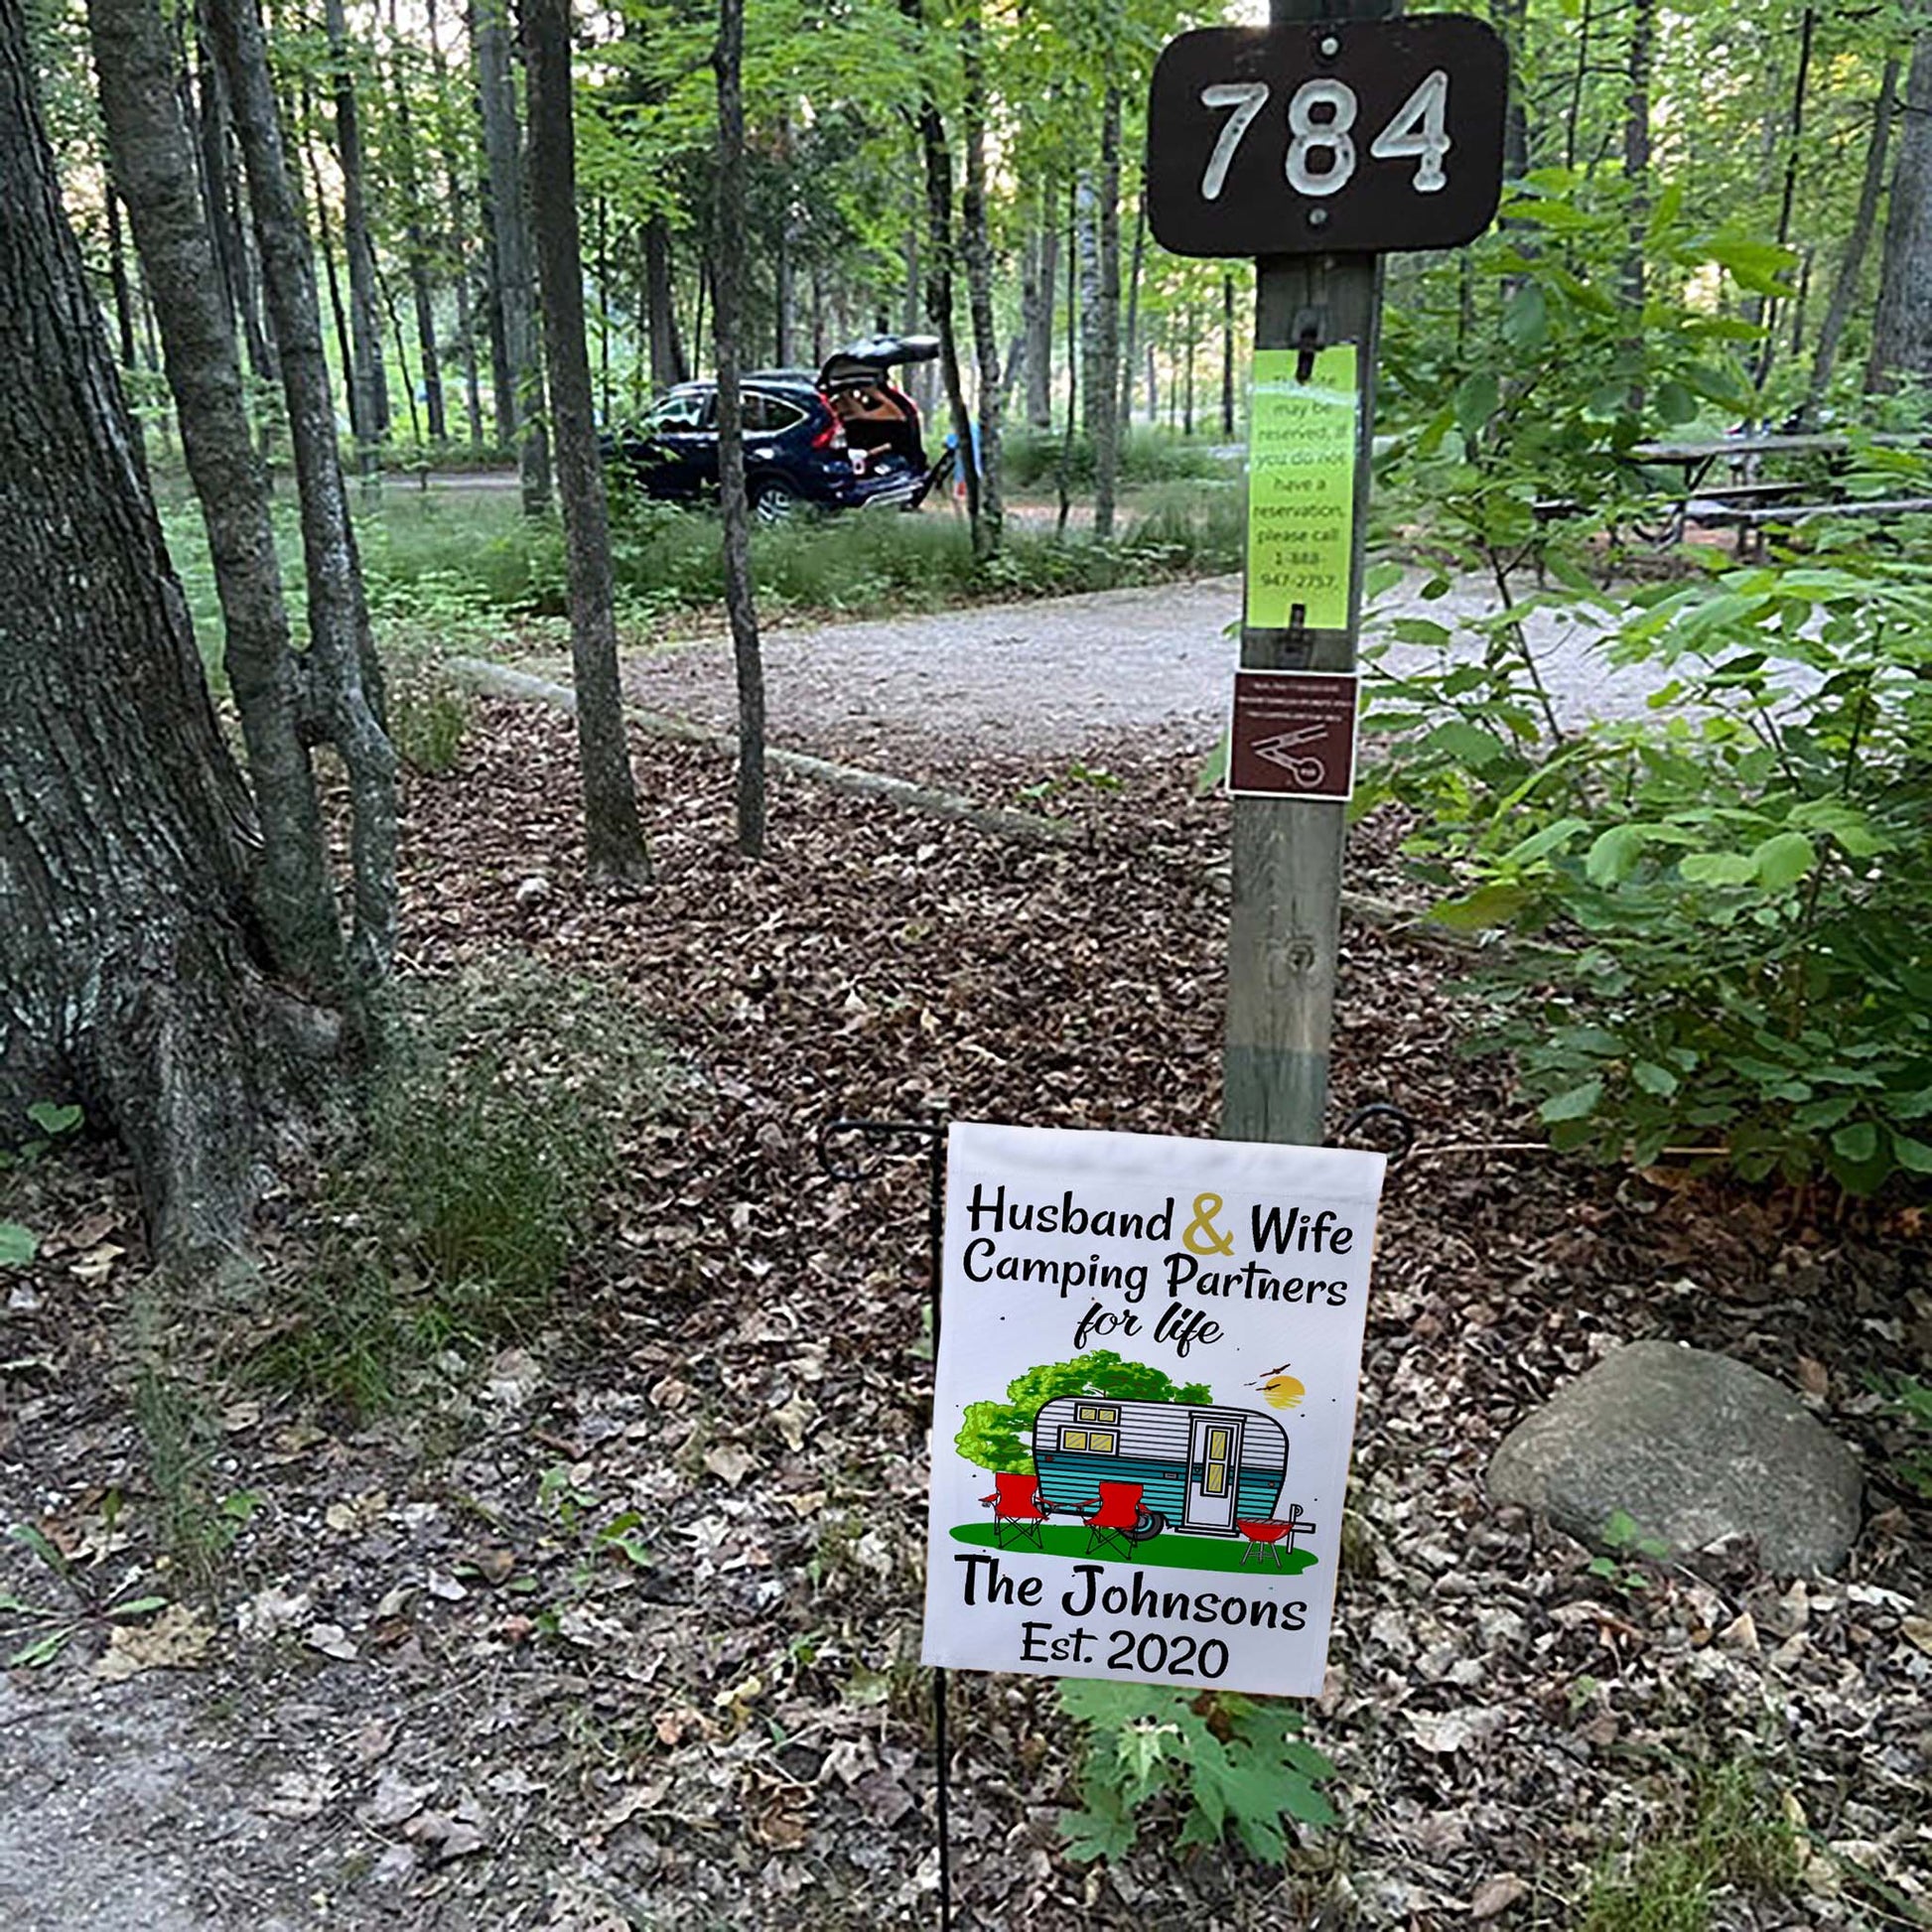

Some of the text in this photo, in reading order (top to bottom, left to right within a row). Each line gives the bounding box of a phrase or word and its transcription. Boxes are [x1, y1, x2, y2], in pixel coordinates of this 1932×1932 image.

[1200, 69, 1451, 200] 784
[1273, 403, 1307, 419] may
[1255, 454, 1289, 471] you
[1292, 452, 1313, 467] do
[1274, 478, 1312, 492] have
[1257, 527, 1339, 545] please call
[966, 1183, 1353, 1257] Husband & Wife
[963, 1237, 1348, 1307] Camping Partners
[1073, 1301, 1224, 1358] for life
[954, 1553, 1308, 1631] The Johnsons
[1020, 1621, 1230, 1679] Est. 2020
